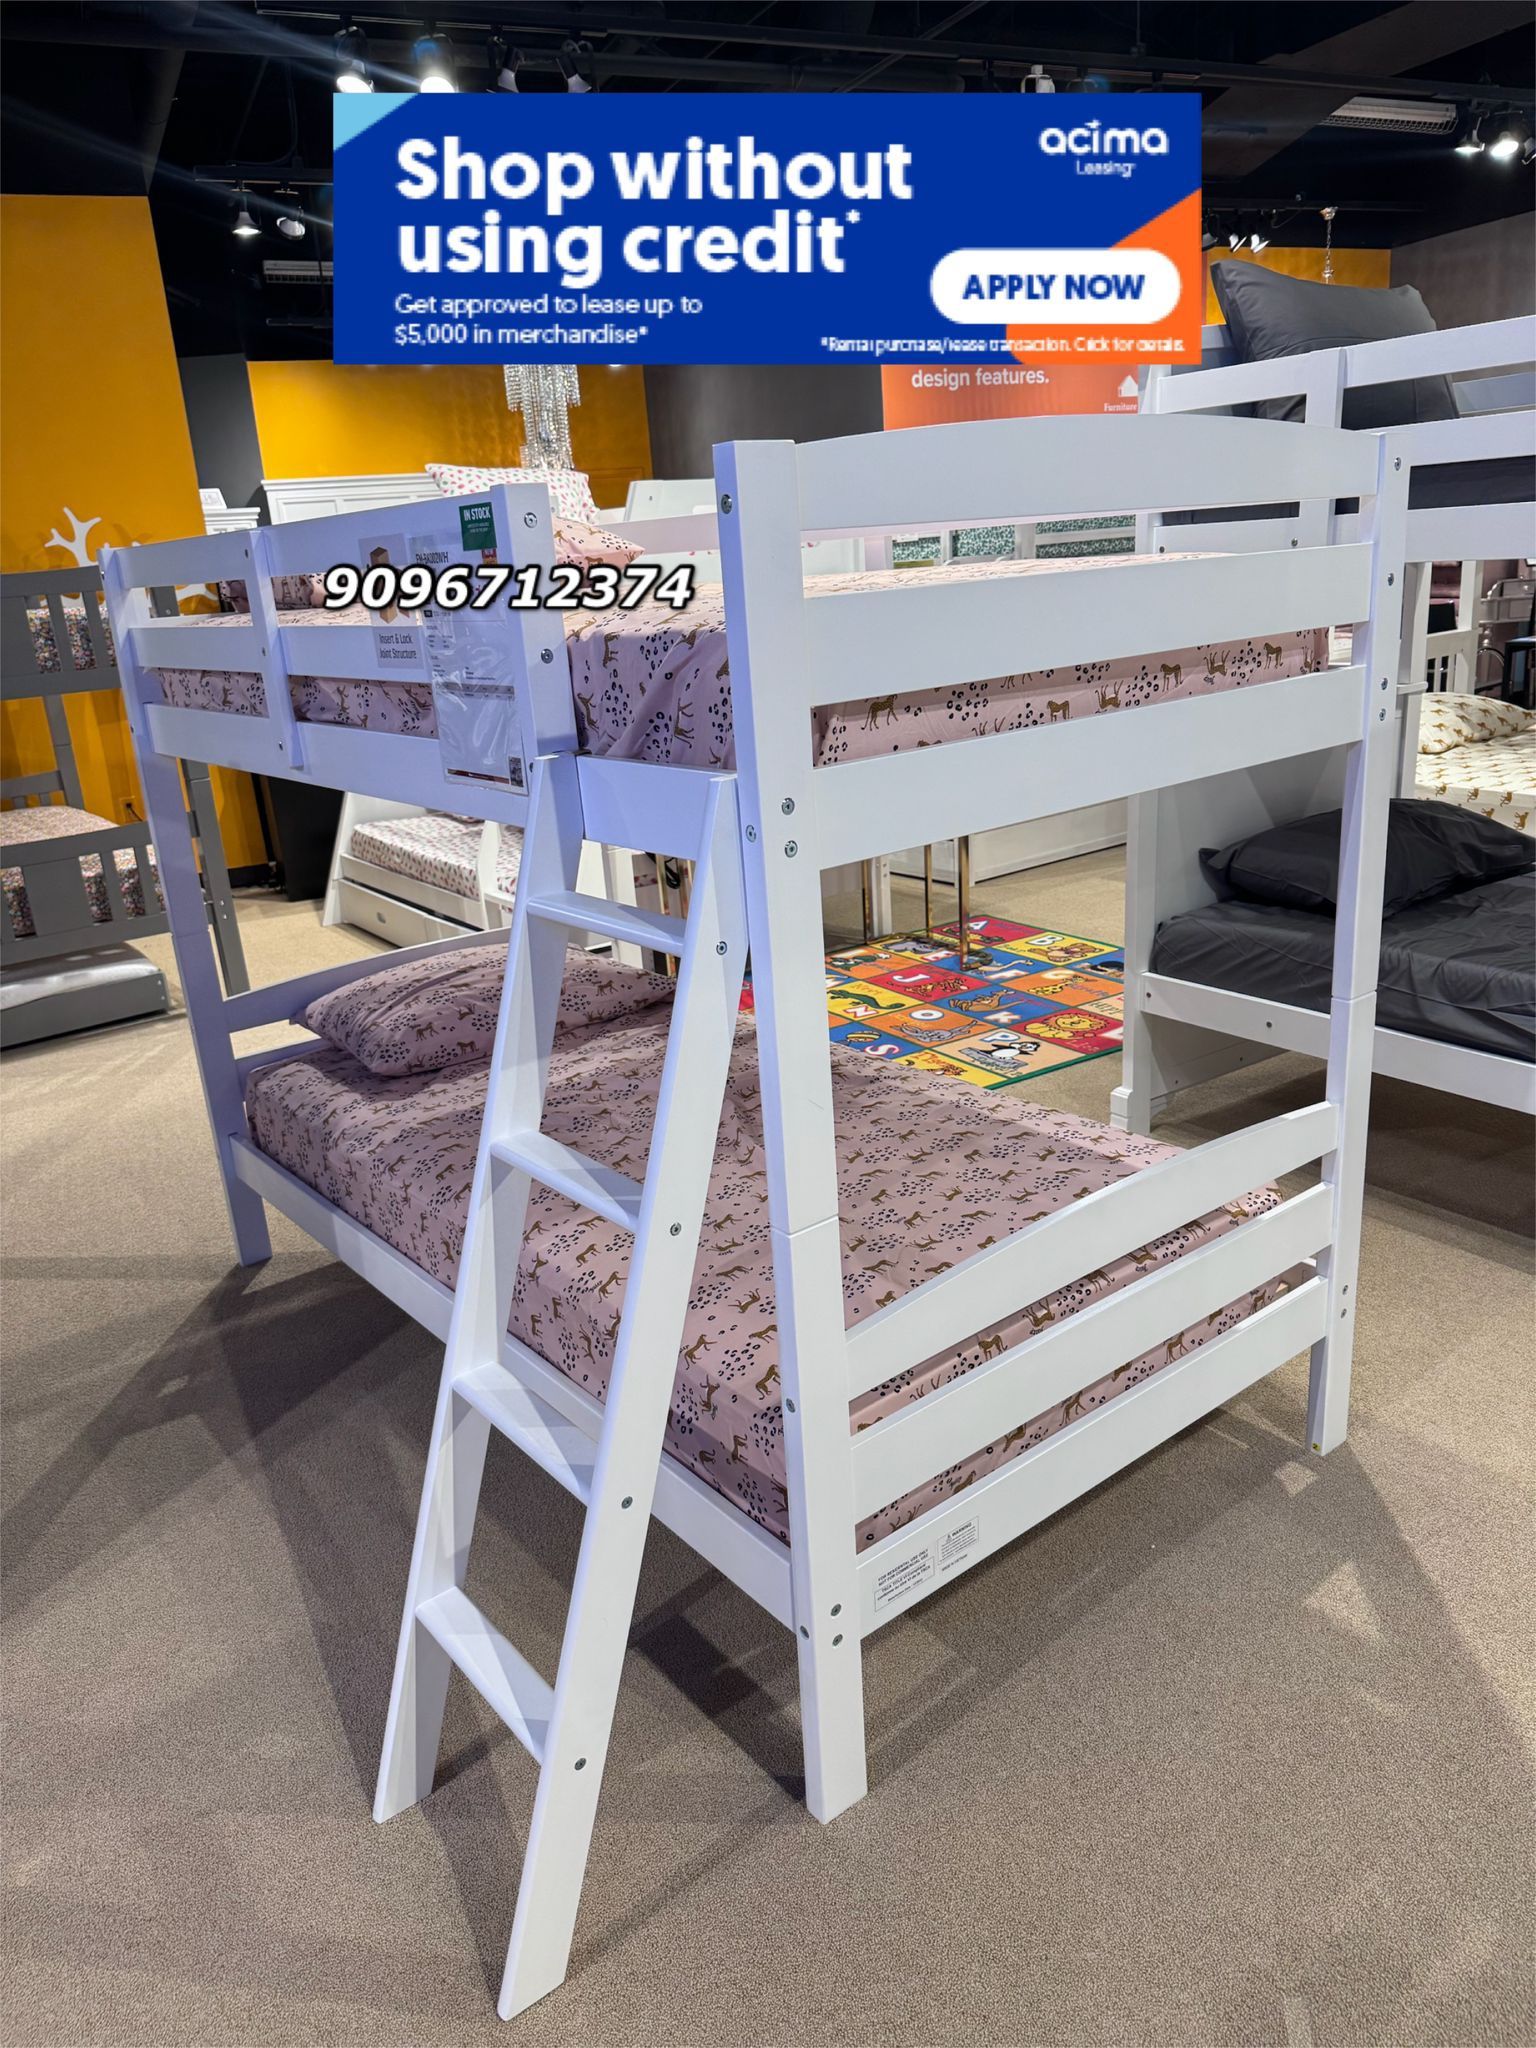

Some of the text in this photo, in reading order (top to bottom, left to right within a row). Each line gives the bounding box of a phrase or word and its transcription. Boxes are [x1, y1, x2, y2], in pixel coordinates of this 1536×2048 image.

[911, 368, 1050, 391] design features.
[1103, 402, 1138, 412] Furniture
[463, 506, 492, 521] IN STOCK
[379, 633, 394, 644] Insert
[400, 633, 413, 644] Lock
[380, 648, 392, 659] Joint
[392, 648, 417, 660] Structure
[1026, 935, 1065, 946] B
[892, 972, 931, 983] J
[844, 1005, 880, 1018] N
[909, 1009, 945, 1021] O
[984, 1011, 1022, 1024] K
[979, 1031, 1021, 1043] P
[864, 1044, 901, 1056] S
